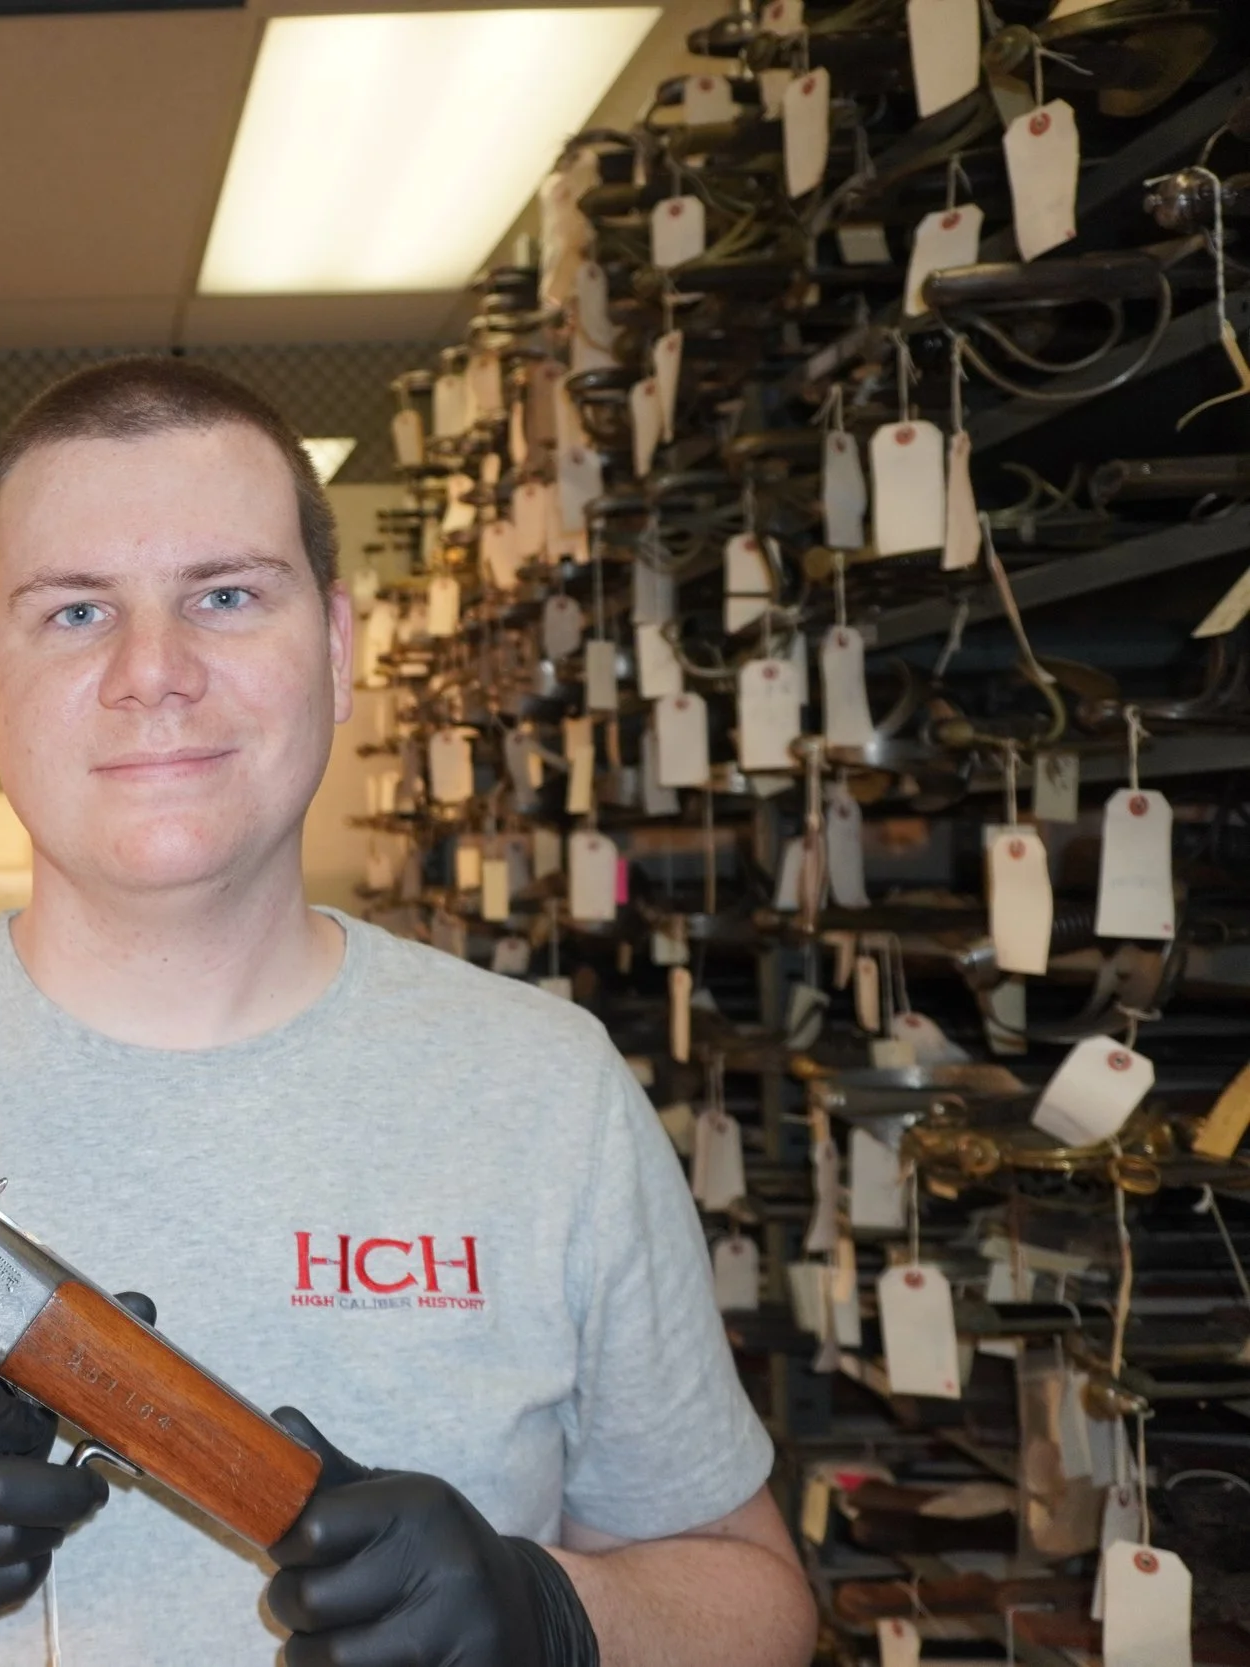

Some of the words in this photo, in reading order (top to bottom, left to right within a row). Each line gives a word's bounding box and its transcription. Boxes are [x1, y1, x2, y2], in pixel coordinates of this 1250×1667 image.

[294, 1231, 483, 1294] HCH
[291, 1293, 335, 1308] HIGH
[338, 1296, 413, 1311] CALIBER
[417, 1294, 486, 1312] HISTORY
